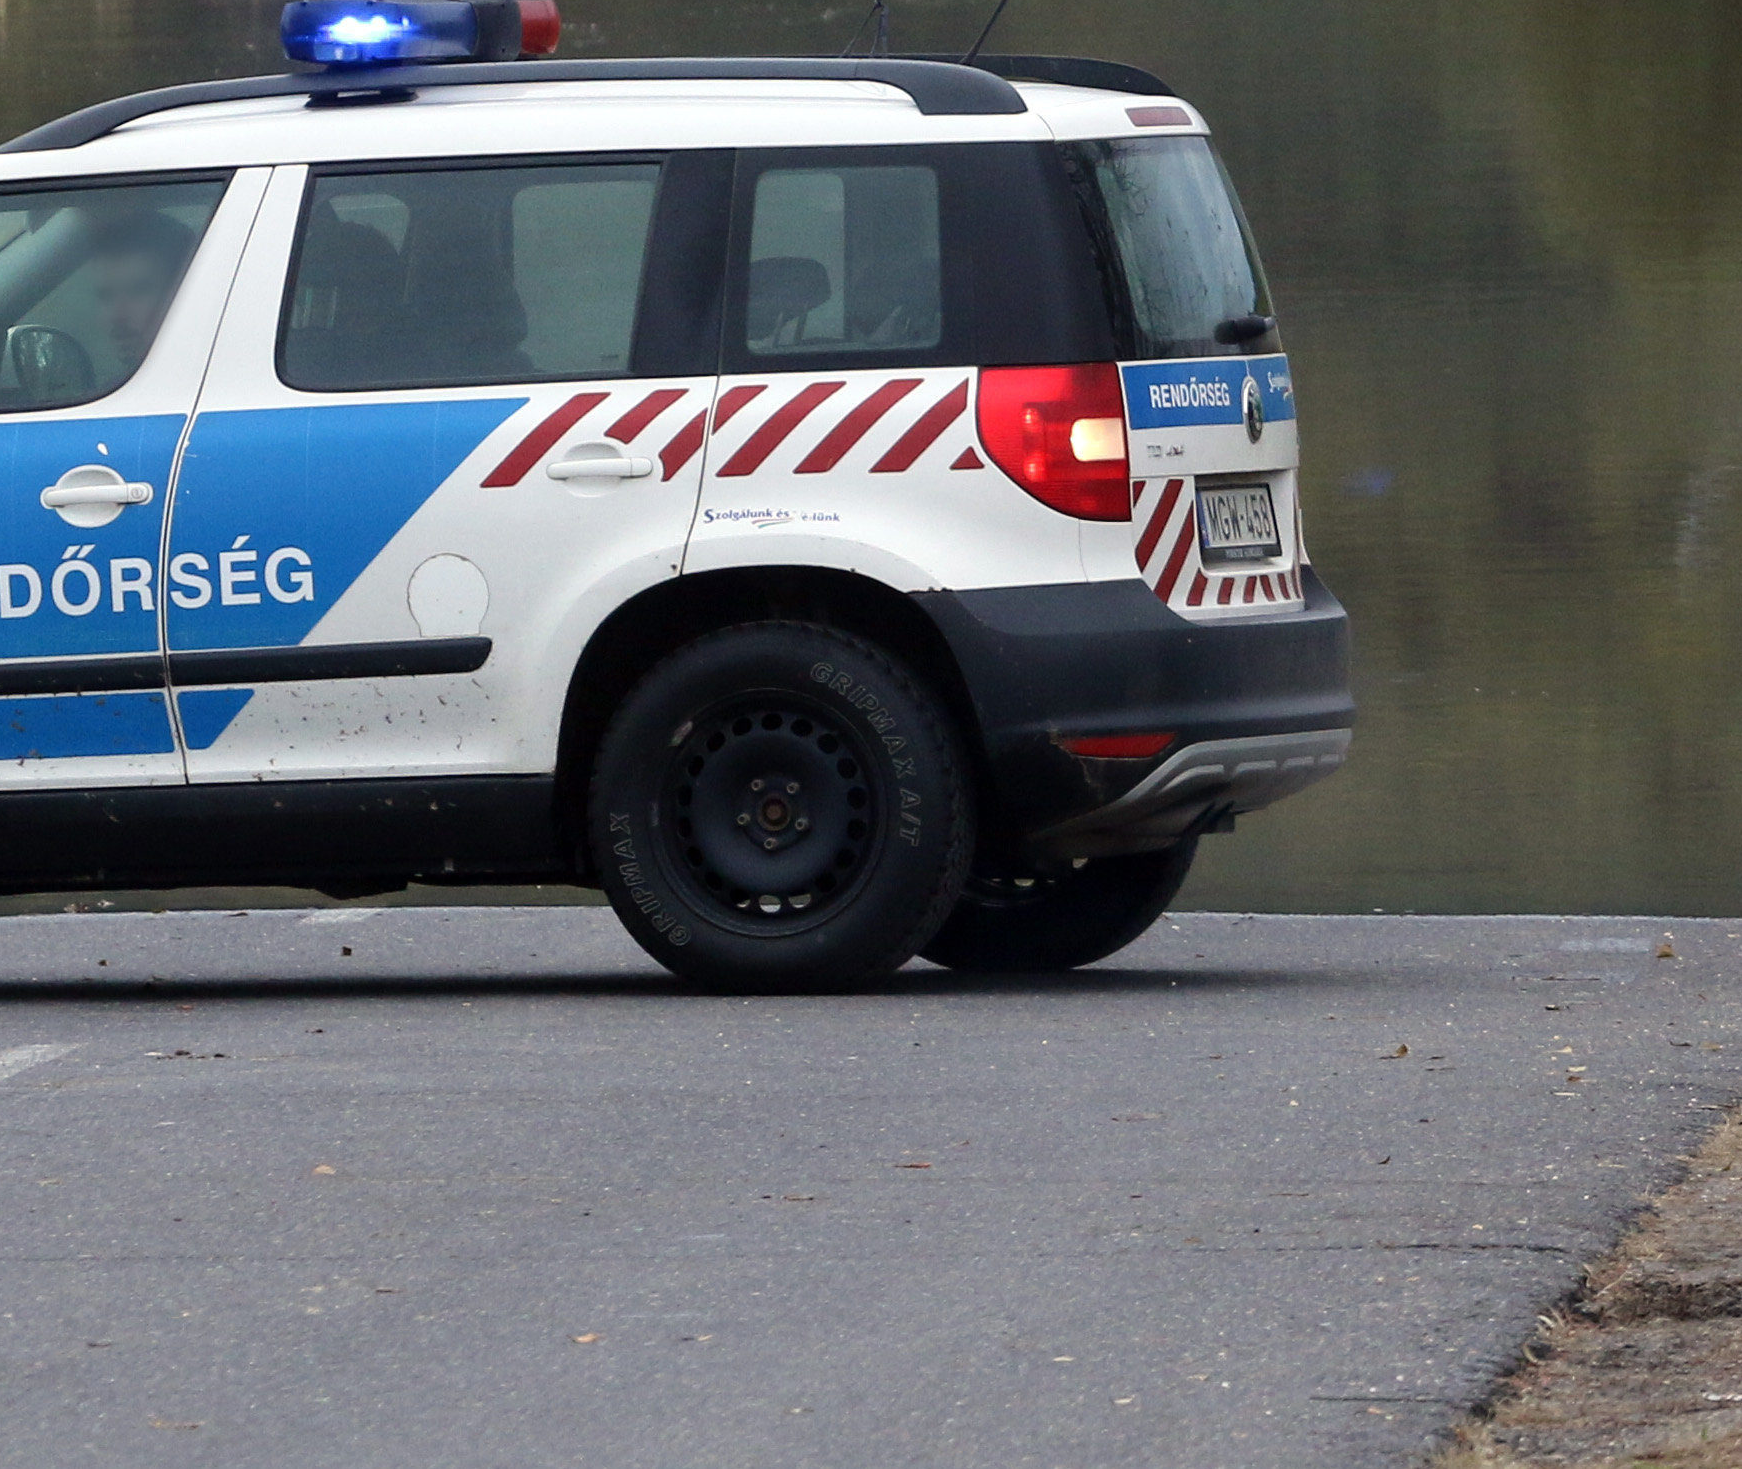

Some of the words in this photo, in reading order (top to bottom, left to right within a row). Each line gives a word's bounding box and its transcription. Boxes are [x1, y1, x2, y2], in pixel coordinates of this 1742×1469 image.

[1149, 376, 1231, 409] RENDŐRSÉG
[1205, 493, 1271, 541] MGW-458
[810, 662, 917, 780] GRIPMAX
[609, 812, 691, 947] GRIPMAX
